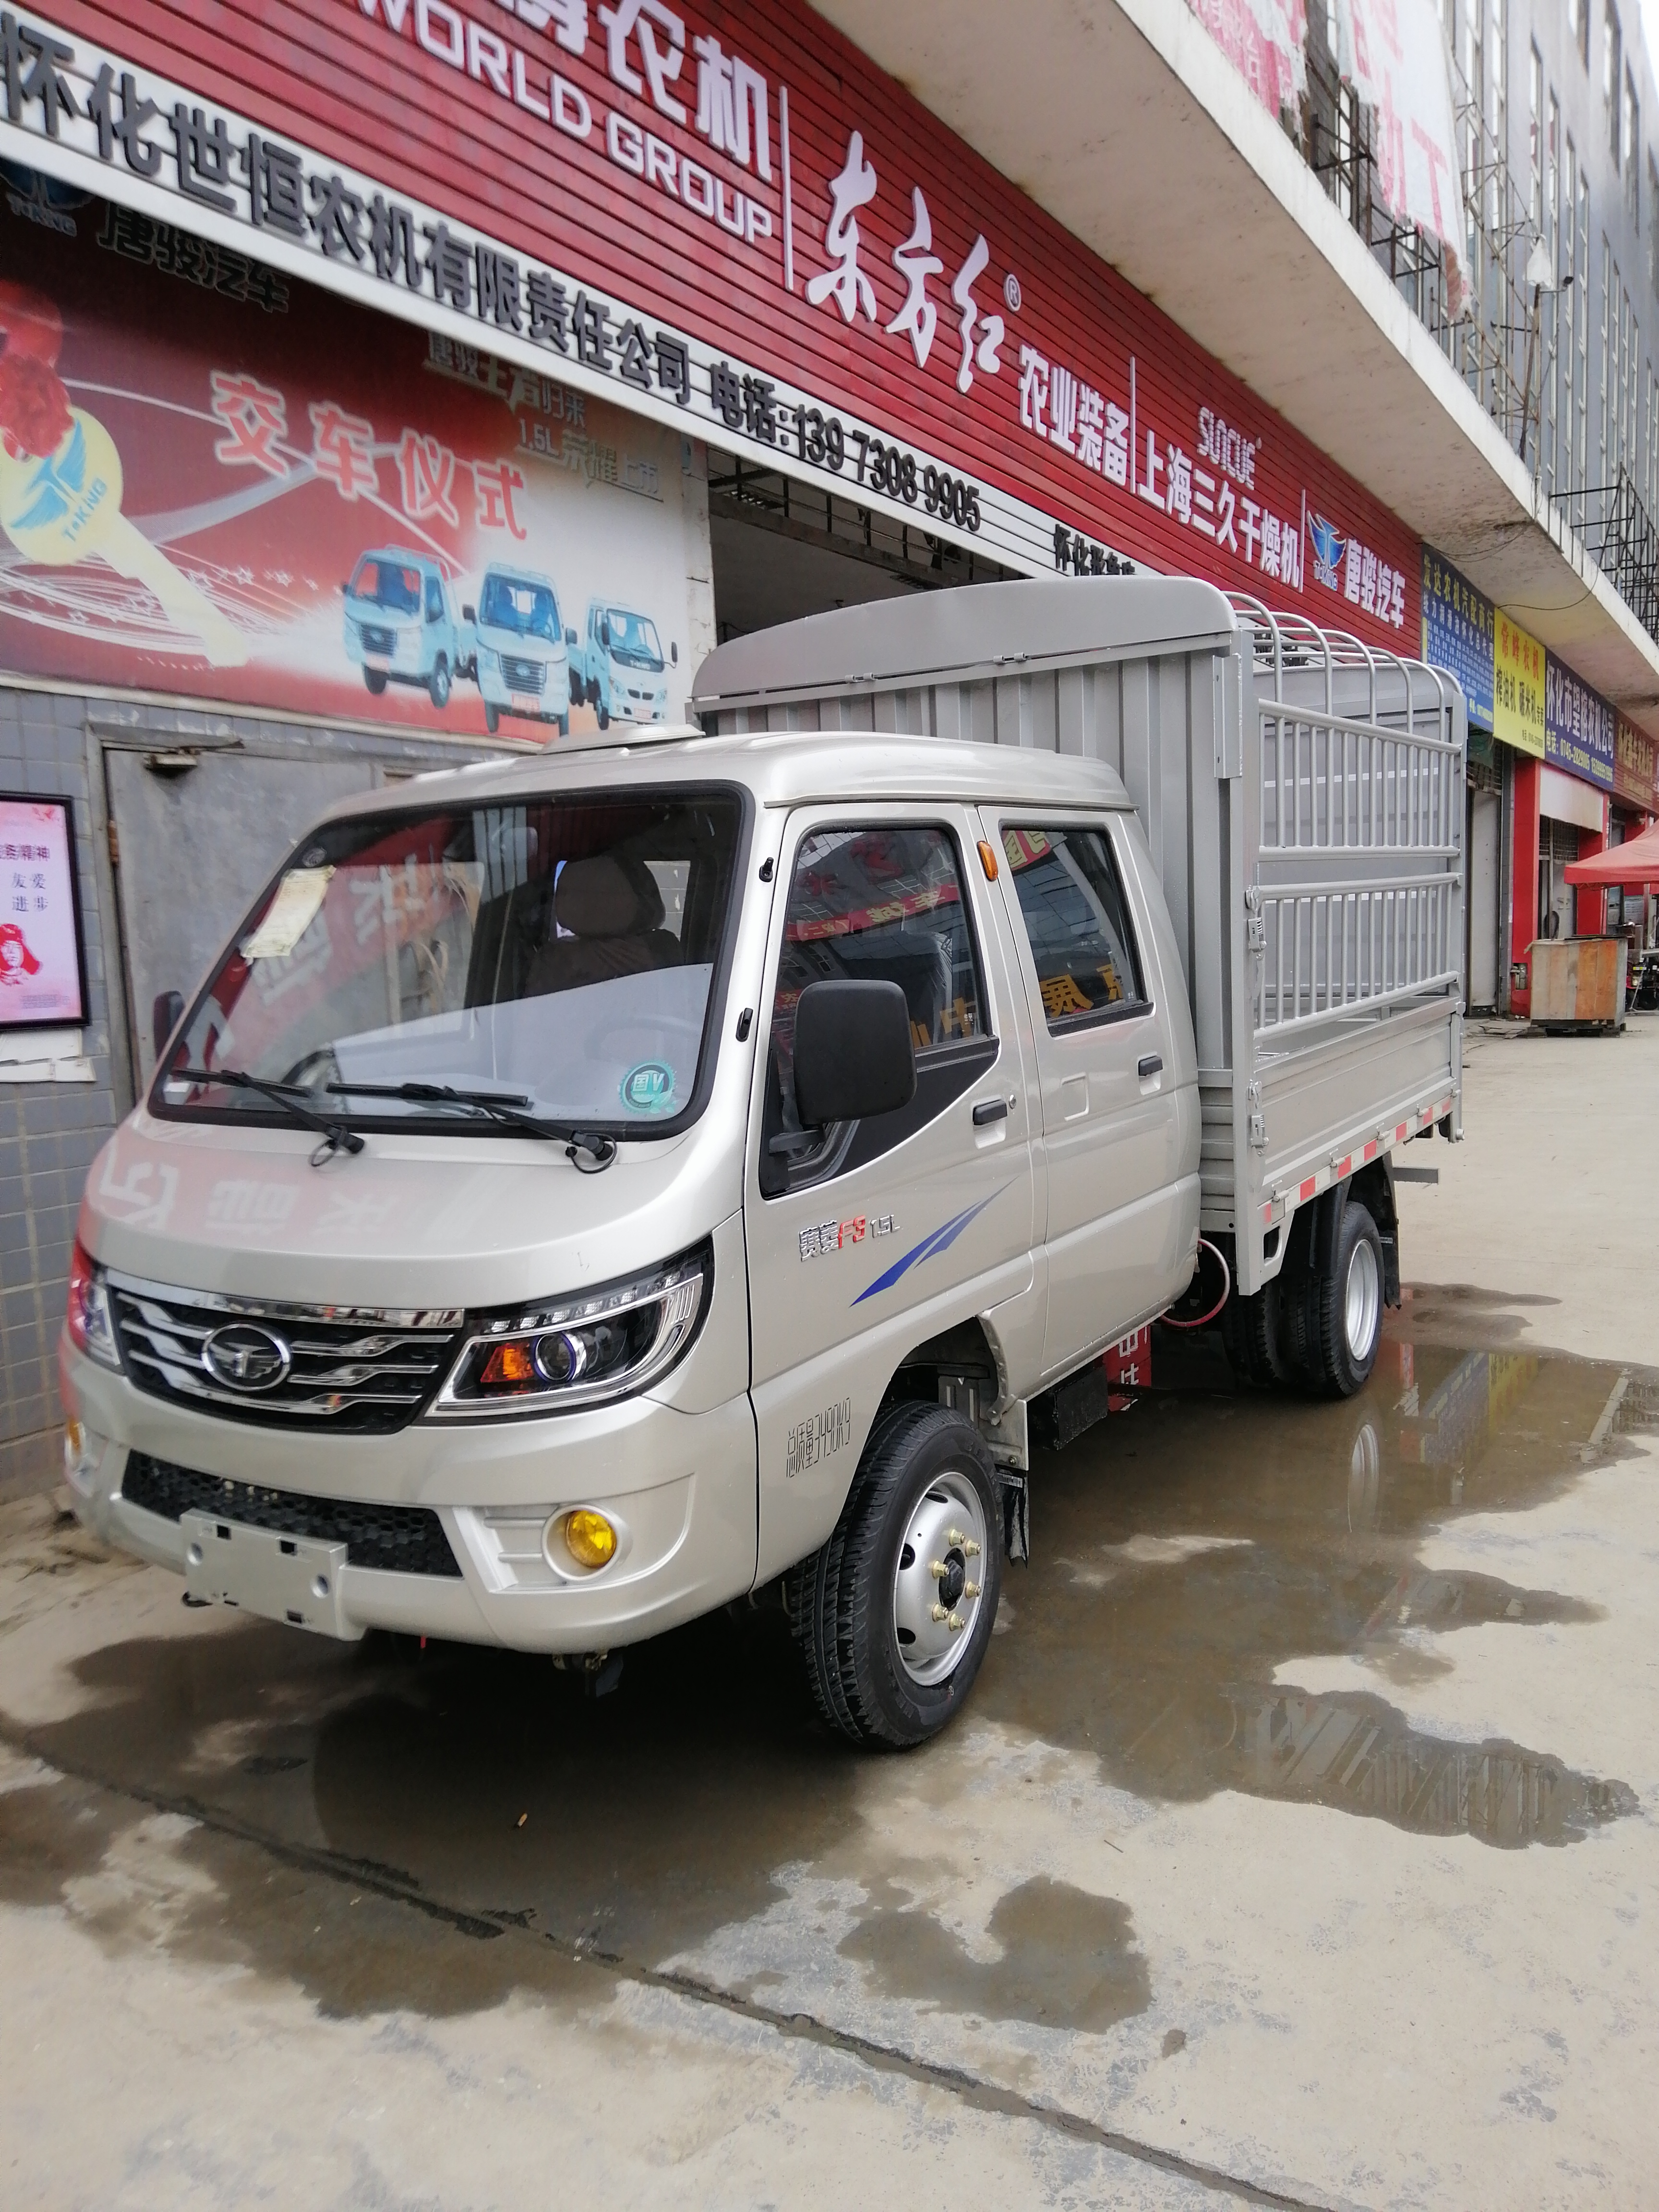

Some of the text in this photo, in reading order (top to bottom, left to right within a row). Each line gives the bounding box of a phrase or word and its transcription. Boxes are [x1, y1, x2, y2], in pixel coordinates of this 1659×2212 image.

[0, 11, 691, 406] 怀化世恒农机有限责任公司
[606, 111, 772, 244] GROUP
[805, 130, 1005, 393] 东方红
[210, 369, 528, 541] 交车仪式
[1019, 344, 1128, 486] 农业装备
[1136, 430, 1300, 591] 上海三久干燥机
[1345, 538, 1406, 629] 唐骏汽车
[0, 844, 50, 862] 务精神
